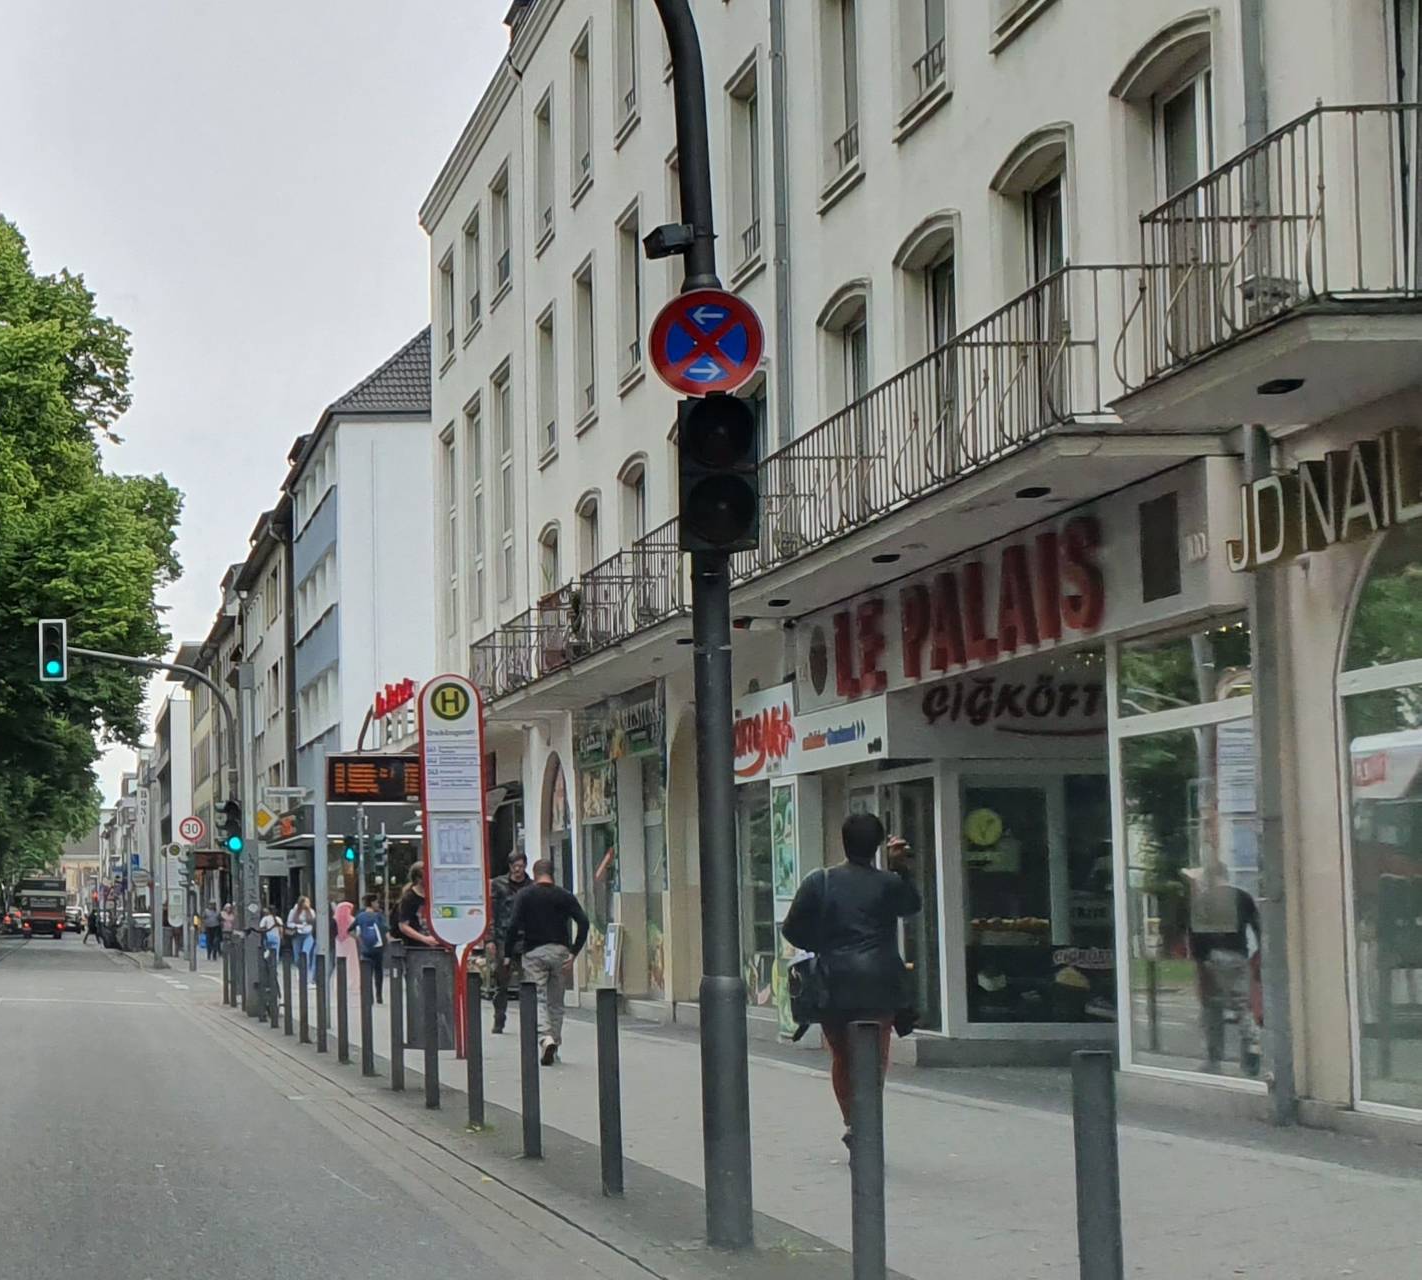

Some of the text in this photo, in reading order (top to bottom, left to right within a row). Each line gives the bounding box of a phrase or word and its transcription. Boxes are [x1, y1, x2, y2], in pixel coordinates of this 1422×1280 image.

[1228, 474, 1285, 572] JD
[834, 515, 1105, 698] LE PALAIS
[441, 690, 460, 712] H
[184, 823, 199, 834] 30
